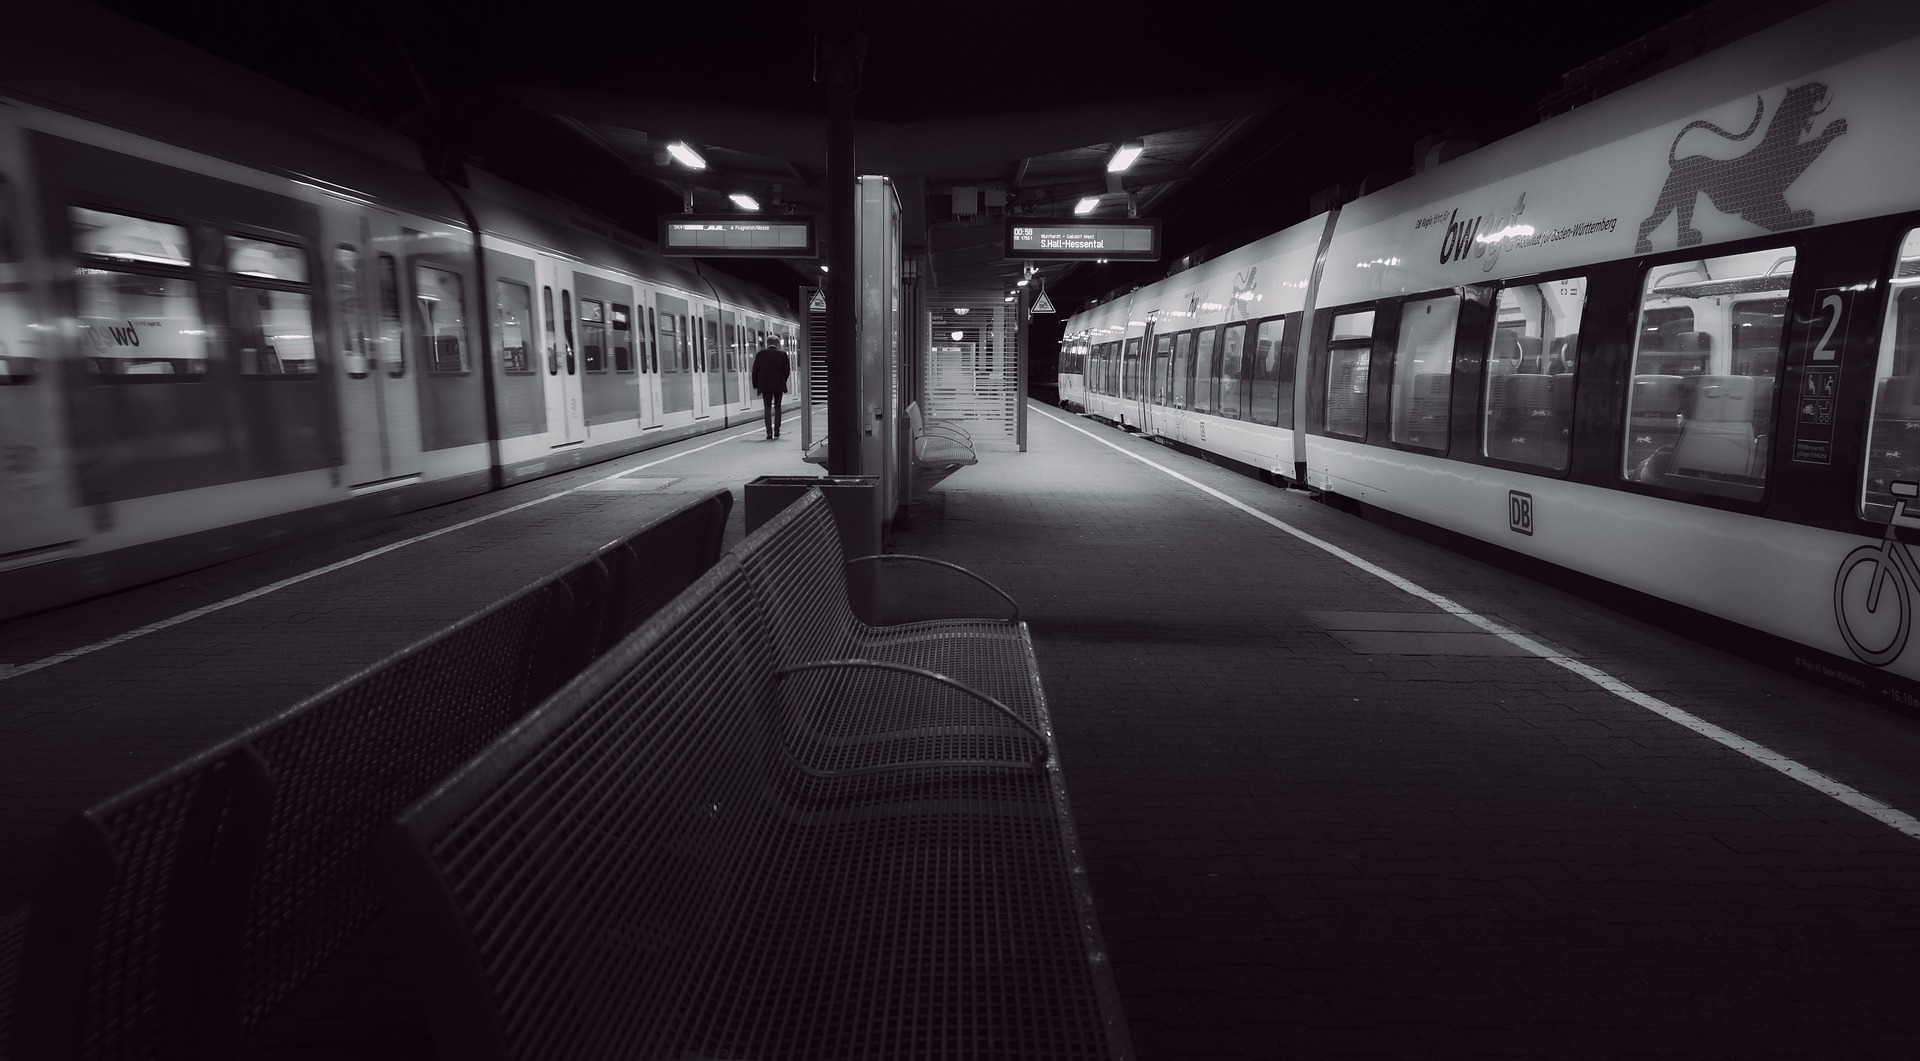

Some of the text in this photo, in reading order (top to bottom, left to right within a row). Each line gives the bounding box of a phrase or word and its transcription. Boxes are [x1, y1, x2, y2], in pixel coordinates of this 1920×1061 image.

[1014, 228, 1033, 236] 00:58
[1551, 217, 1618, 242] Baden-Württemberg
[1041, 240, 1104, 249] S.Hall-Hessental
[1812, 294, 1843, 361] 2
[1511, 496, 1531, 529] DB
